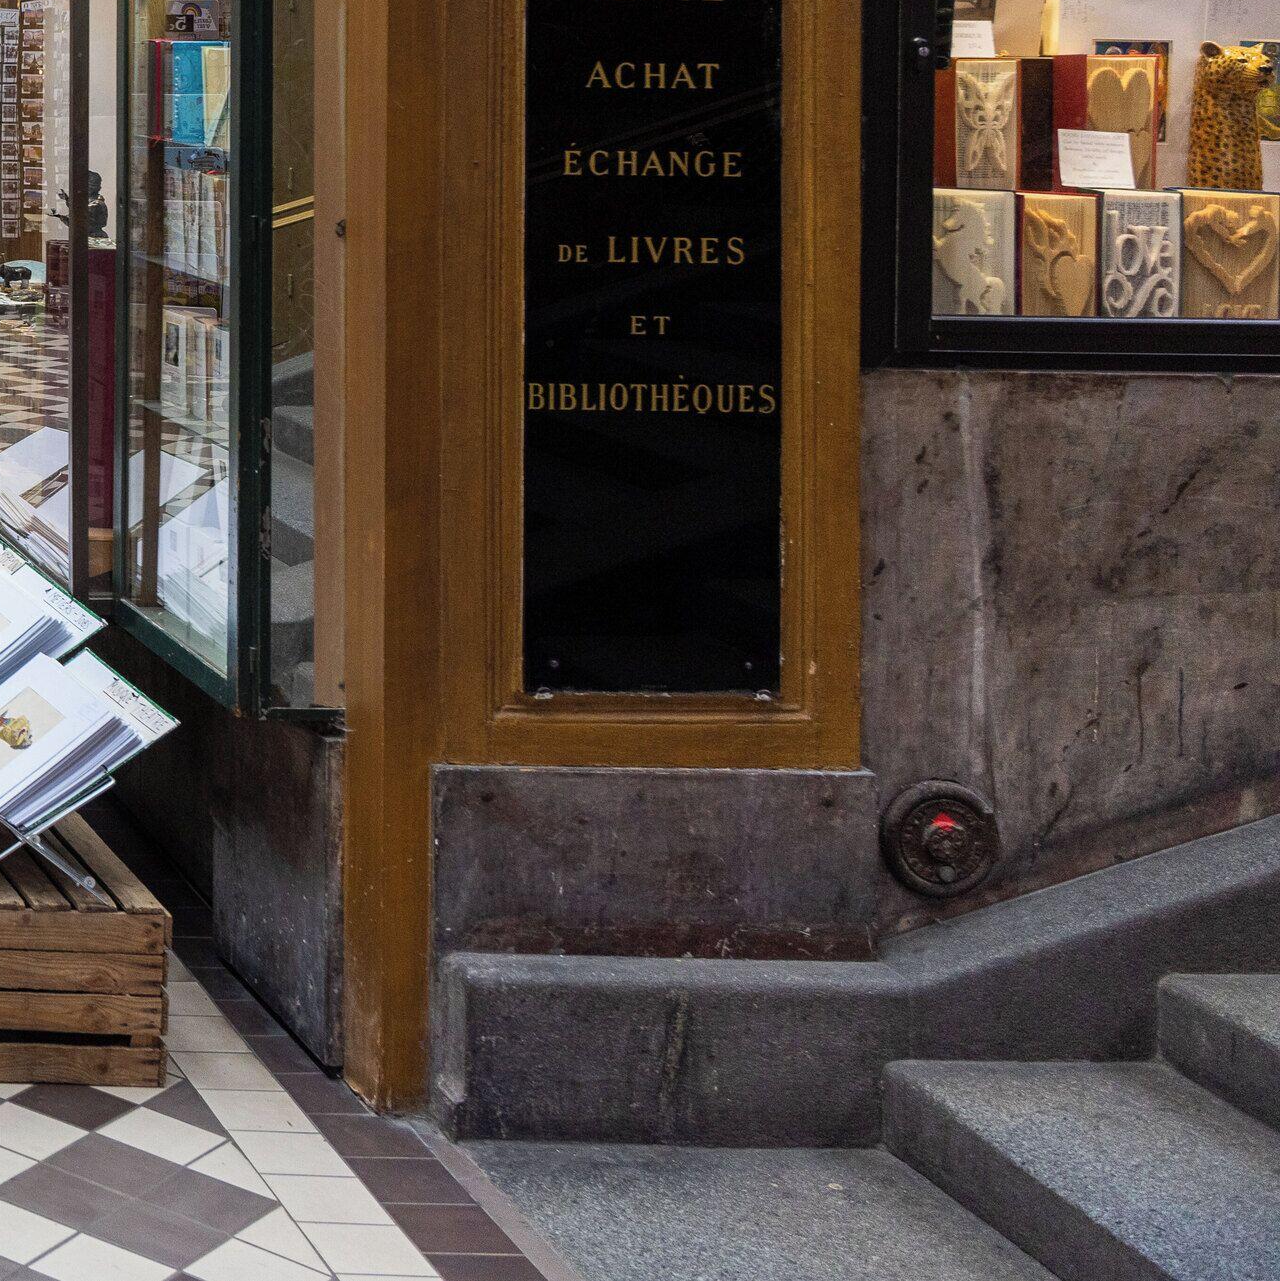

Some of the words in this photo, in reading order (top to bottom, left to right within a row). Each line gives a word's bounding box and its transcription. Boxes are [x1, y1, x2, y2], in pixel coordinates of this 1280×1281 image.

[586, 61, 720, 90] ACHAT
[562, 143, 743, 179] ÉCHANGE
[558, 244, 588, 263] DE
[608, 235, 745, 266] LIVRES
[630, 315, 671, 336] ET
[527, 374, 776, 415] BIBLIOTHÈQUES
